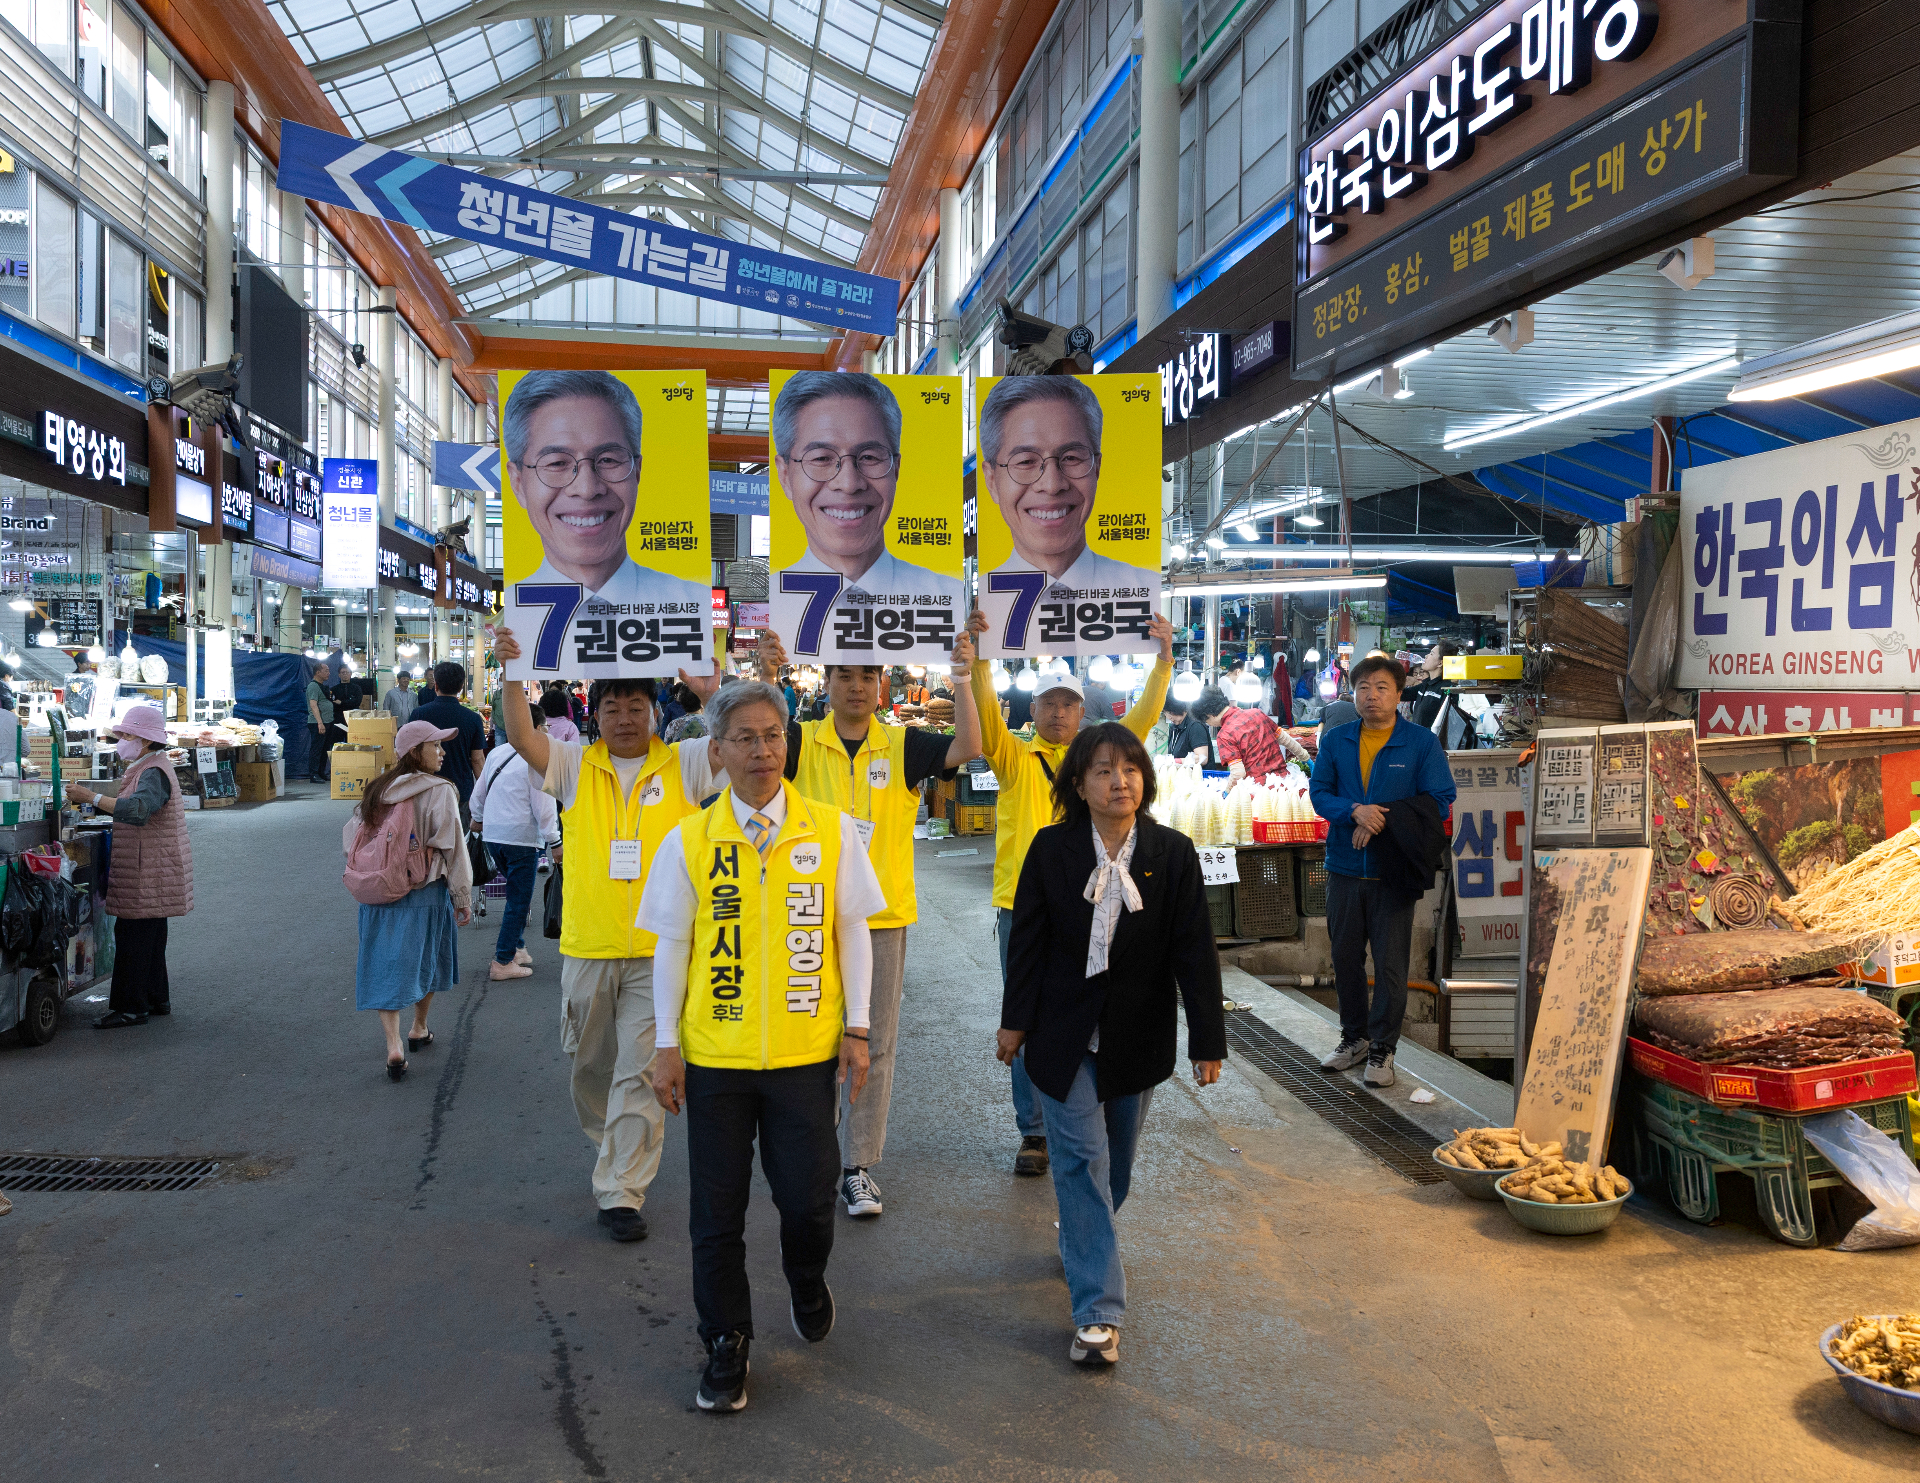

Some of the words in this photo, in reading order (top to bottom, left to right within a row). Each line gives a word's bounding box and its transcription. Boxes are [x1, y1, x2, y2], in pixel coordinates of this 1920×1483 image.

[1312, 283, 1368, 339] 정관장,
[1384, 251, 1430, 305] 홍삼,
[1449, 214, 1492, 273] 벌꿀
[1502, 181, 1554, 243] 제품
[1565, 141, 1625, 214] 도매
[1639, 99, 1708, 176] 상가
[457, 181, 595, 259] 청년몰
[608, 221, 729, 292] 가는길
[737, 258, 818, 294] 청년몰에서
[821, 277, 873, 305] 즐겨라!
[662, 387, 694, 401] 정의당
[921, 391, 951, 405] 정의당
[1121, 389, 1151, 403] 정의당
[45, 410, 126, 487] 태영상회
[258, 469, 288, 508] 지하상가
[338, 475, 364, 489] 신관
[1, 516, 49, 530] Brand
[328, 505, 373, 523] 청년몰
[897, 516, 948, 531] 같이살자
[1097, 513, 1147, 527] 같이살자
[639, 521, 694, 536] 같이살자
[1097, 527, 1150, 541] 서울혁명!
[640, 536, 698, 552] 서울혁명!
[897, 532, 952, 546] 서울혁명!
[1693, 473, 1904, 637] 한국인삼
[270, 558, 289, 579] Brand
[846, 593, 887, 606] 뿌리부터
[889, 594, 910, 606] 바꿀
[911, 594, 953, 606] 서울시장
[1050, 588, 1089, 600] 뿌리부터
[1091, 588, 1110, 600] 바꿀
[1111, 587, 1150, 599] 서울시장
[587, 603, 631, 616] 뿌리부터
[632, 603, 655, 615] 바꿀
[657, 602, 700, 614] 서울시장
[780, 571, 843, 657] 7
[987, 570, 1048, 651] 7
[515, 582, 583, 671] 7
[833, 608, 956, 651] 권영국
[1038, 601, 1153, 643] 권영국
[574, 617, 704, 663] 권영국
[1709, 652, 1774, 675] KOREA
[1783, 649, 1883, 675] GINSENG
[1453, 766, 1499, 787] 벌꿀
[794, 853, 817, 865] 정의당
[709, 845, 744, 1000] 서울시장
[786, 883, 823, 1018] 권영국
[712, 1004, 743, 1022] 후보
